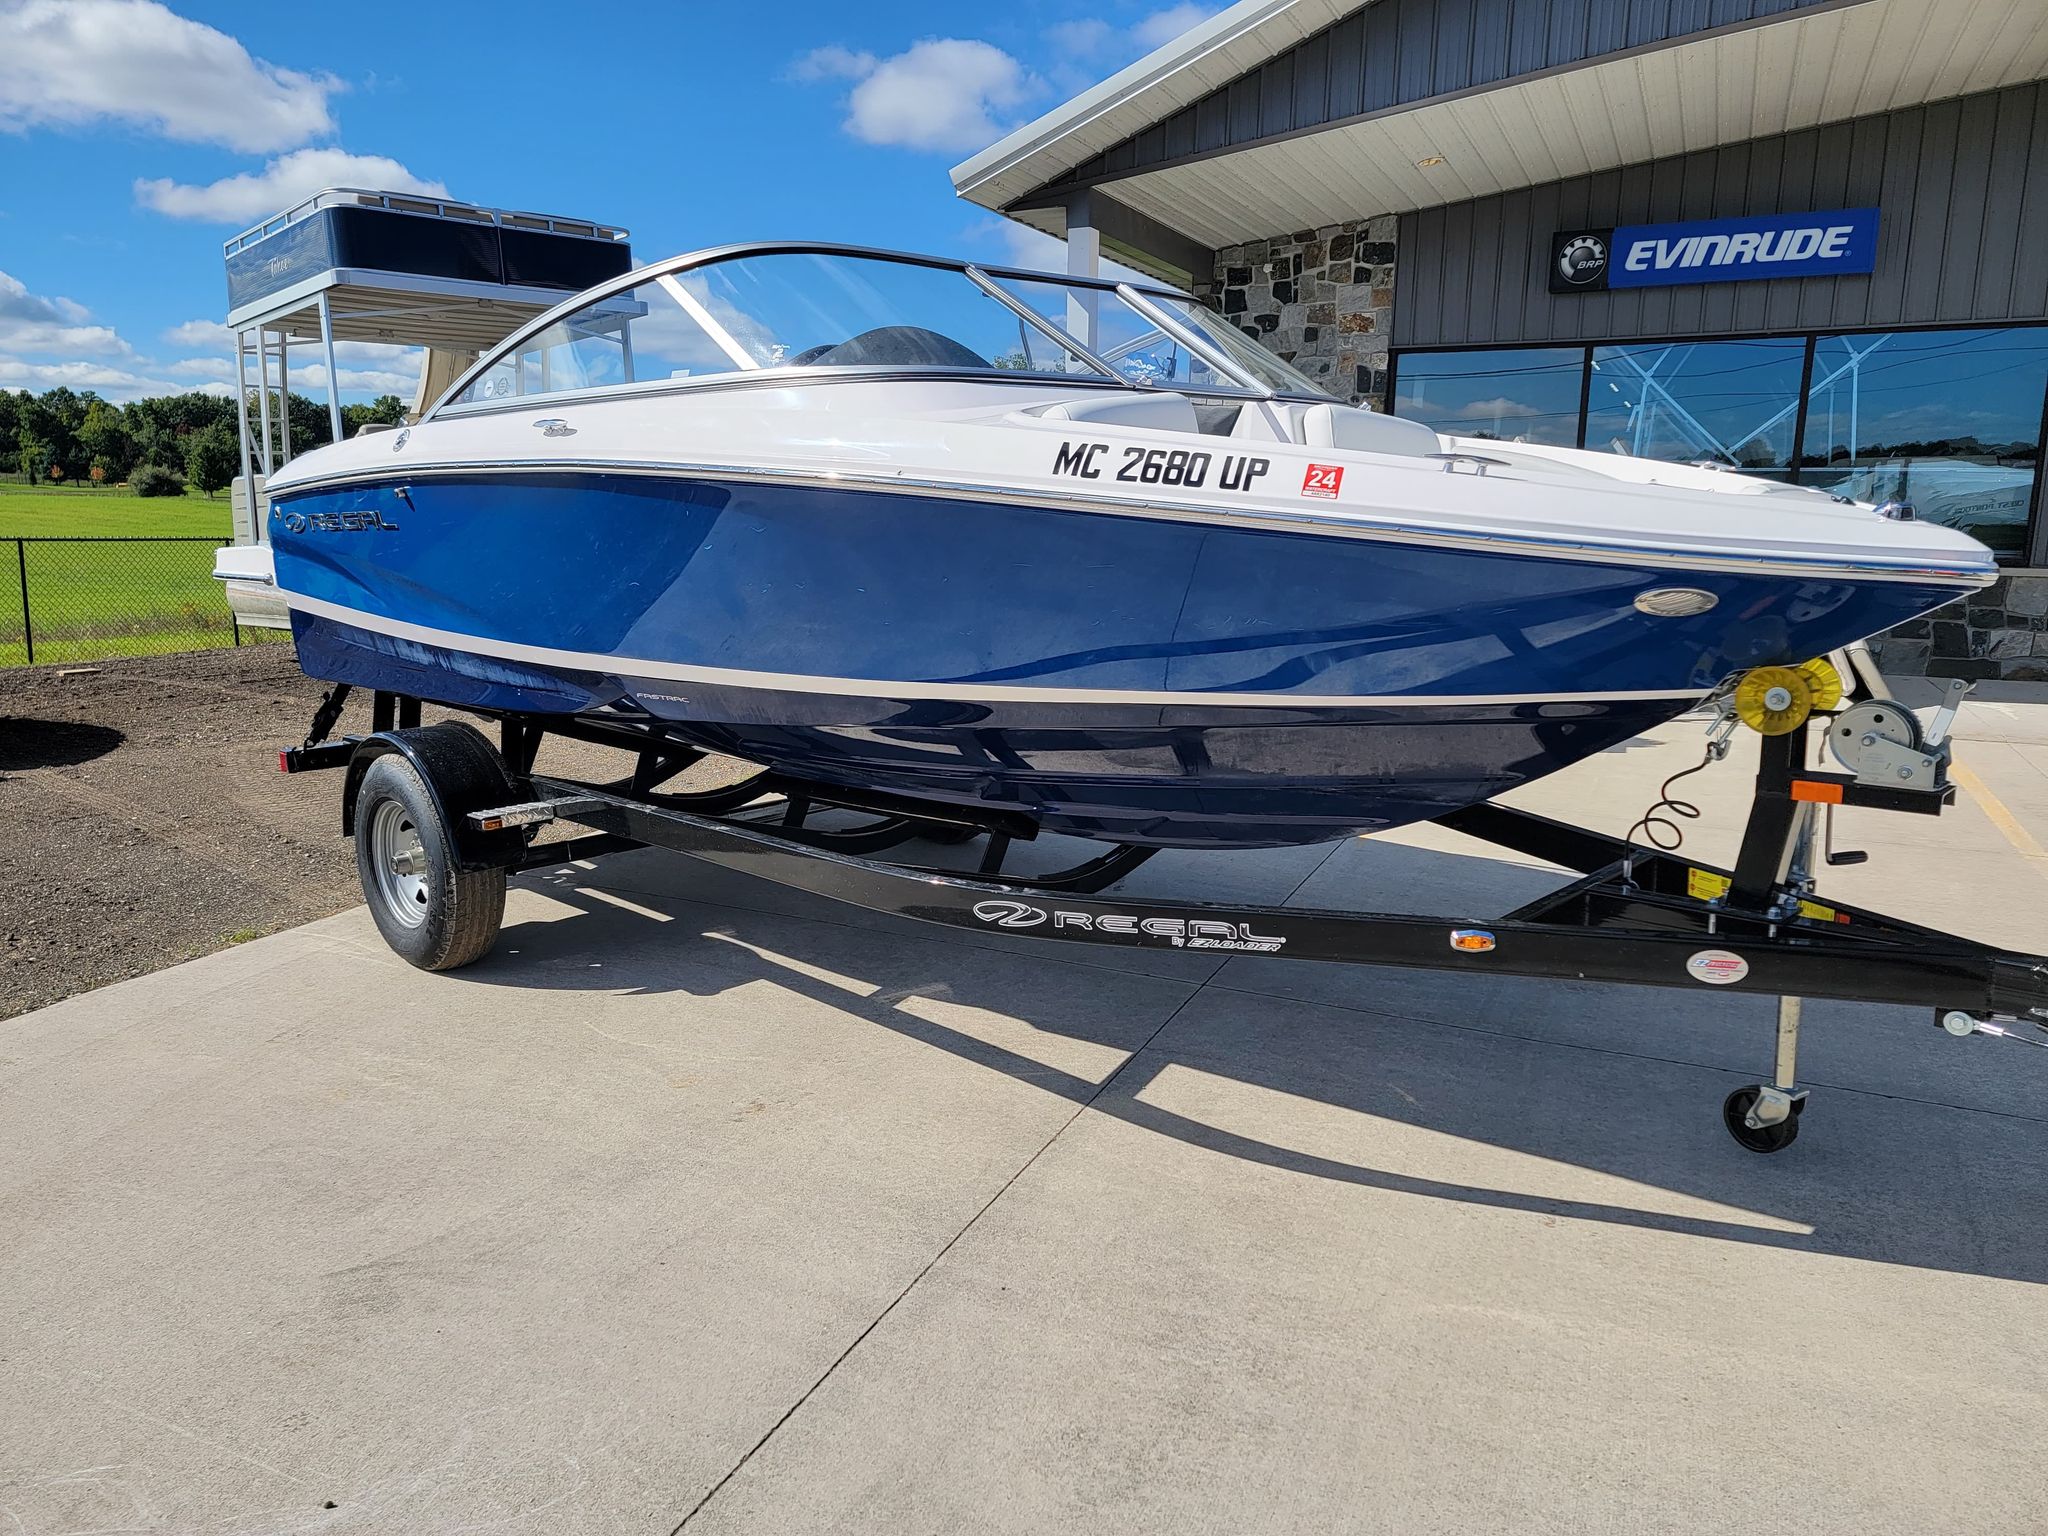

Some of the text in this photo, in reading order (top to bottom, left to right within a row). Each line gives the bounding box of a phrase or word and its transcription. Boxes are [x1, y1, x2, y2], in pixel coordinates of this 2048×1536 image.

[1625, 225, 1854, 272] EVINRUDE
[1576, 260, 1604, 270] BRP
[1052, 441, 1270, 491] MC 2680 UP
[1307, 470, 1337, 488] 24
[307, 510, 399, 532] REGAL
[636, 692, 690, 703] FASTRAC
[1054, 910, 1287, 943] REGAL
[1171, 936, 1185, 947] By
